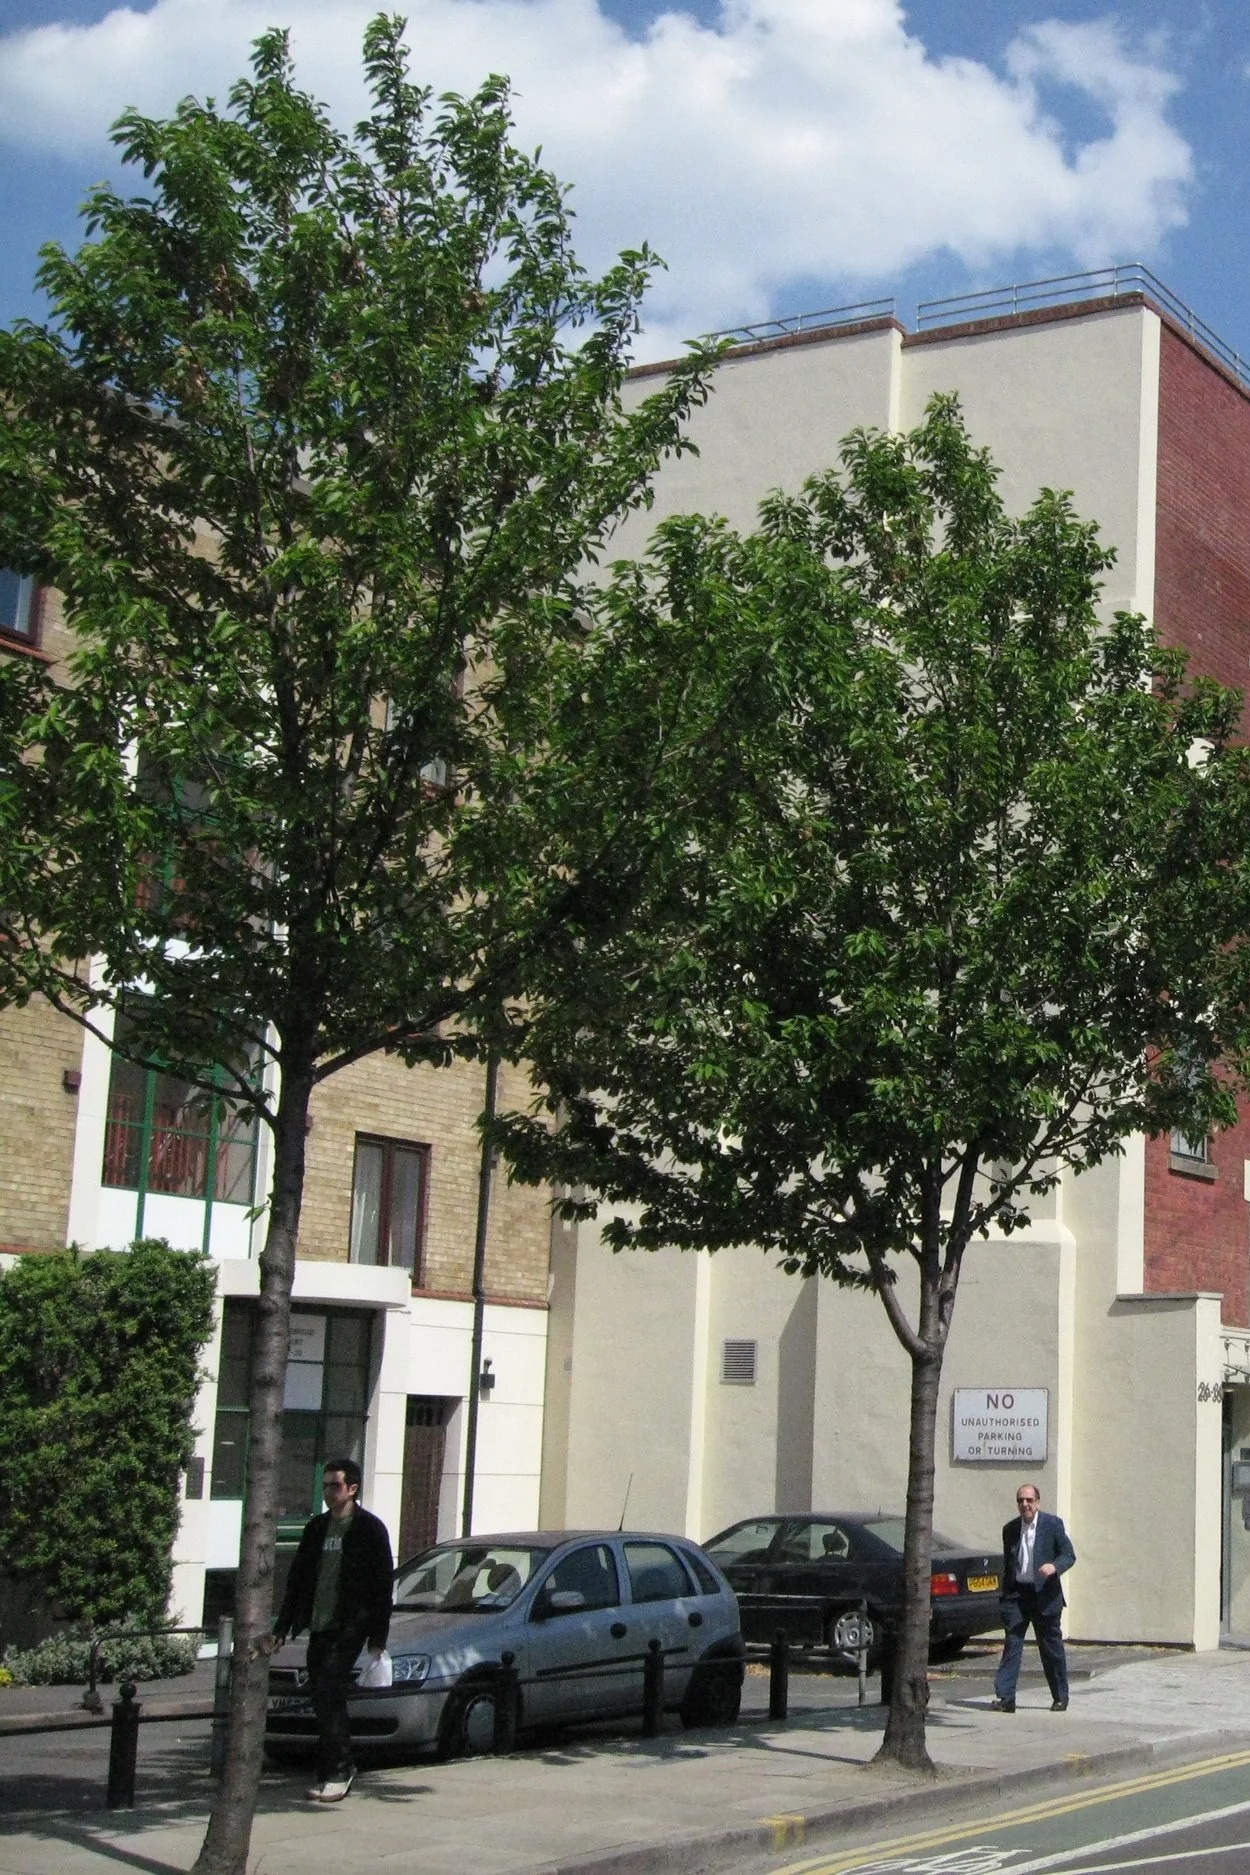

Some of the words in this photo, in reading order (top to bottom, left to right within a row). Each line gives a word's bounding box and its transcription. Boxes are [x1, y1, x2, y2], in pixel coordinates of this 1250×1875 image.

[986, 1394, 1014, 1409] NO
[961, 1418, 1040, 1427] UNAUTHORISED
[978, 1432, 1022, 1441] PARKING
[968, 1446, 981, 1455] OR
[988, 1446, 1033, 1456] TURNING
